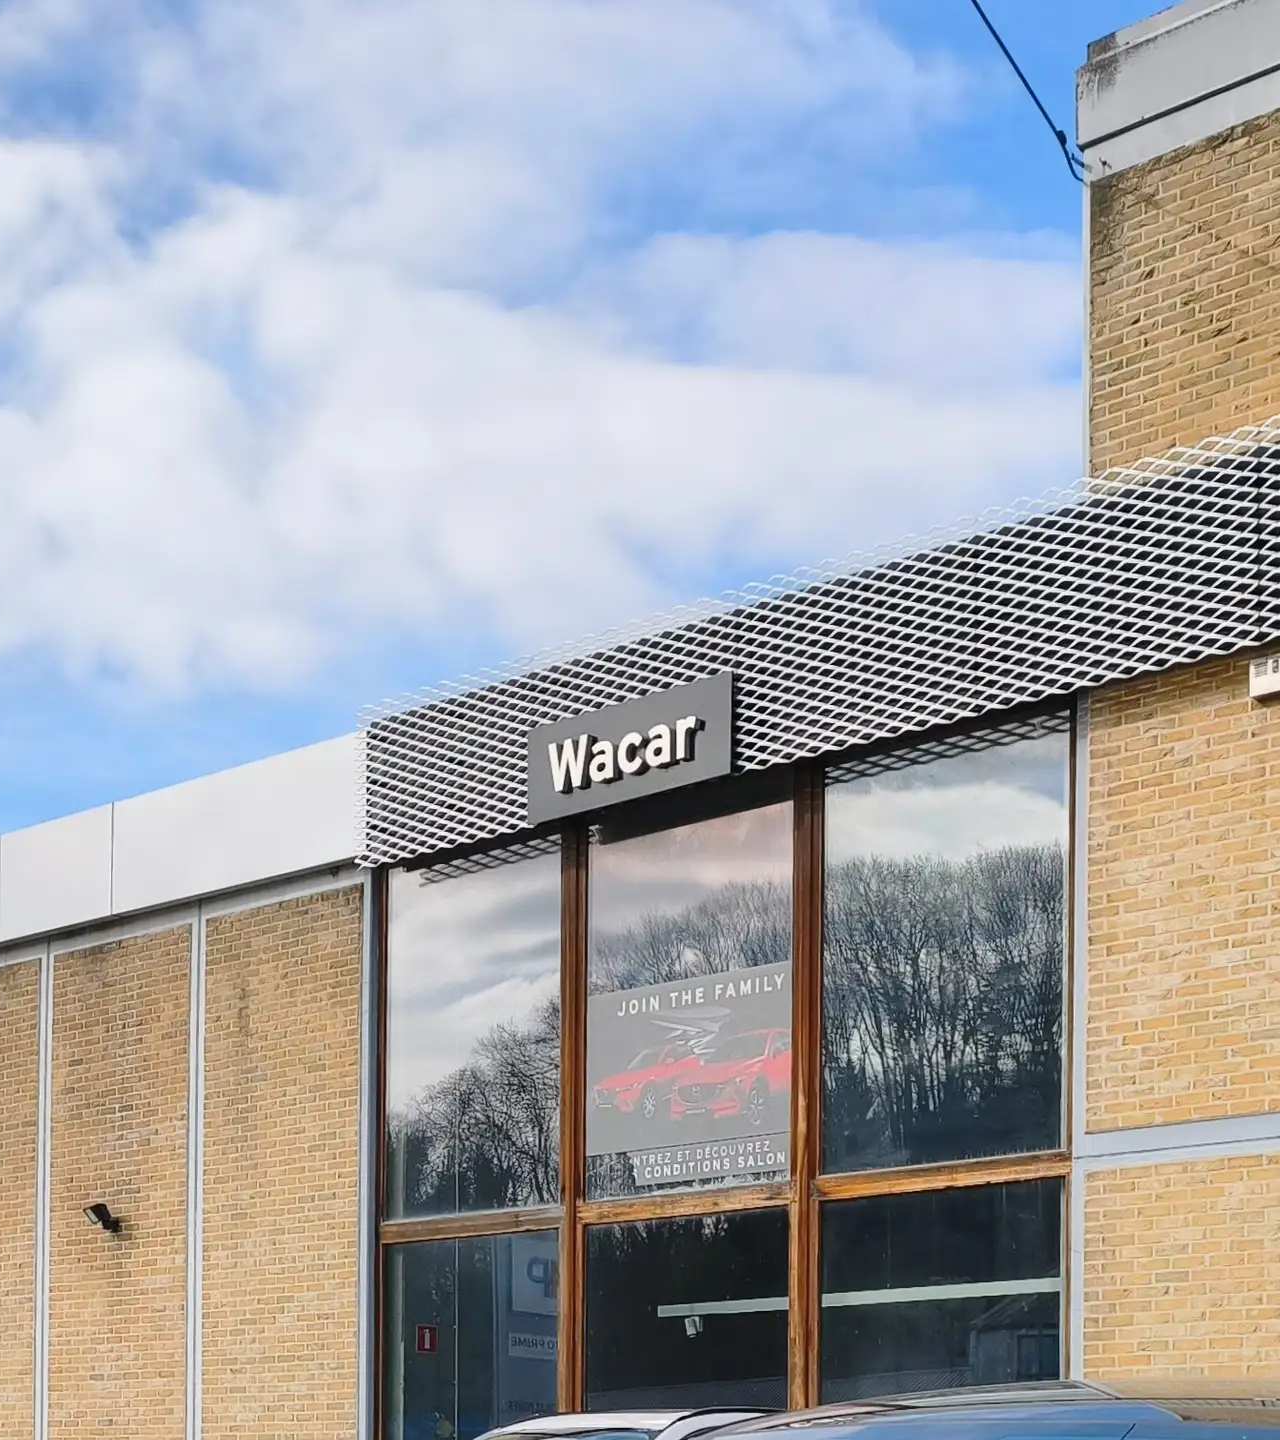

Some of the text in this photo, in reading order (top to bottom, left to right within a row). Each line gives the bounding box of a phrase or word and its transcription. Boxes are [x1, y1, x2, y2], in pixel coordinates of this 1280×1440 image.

[548, 712, 704, 793] Wacar
[617, 973, 786, 1017] JOIN THE FAMILY
[632, 1140, 771, 1166] NTREZ ET DÉCOUVREZ
[644, 1157, 731, 1179] CONDITIONS
[737, 1151, 786, 1169] SALON
